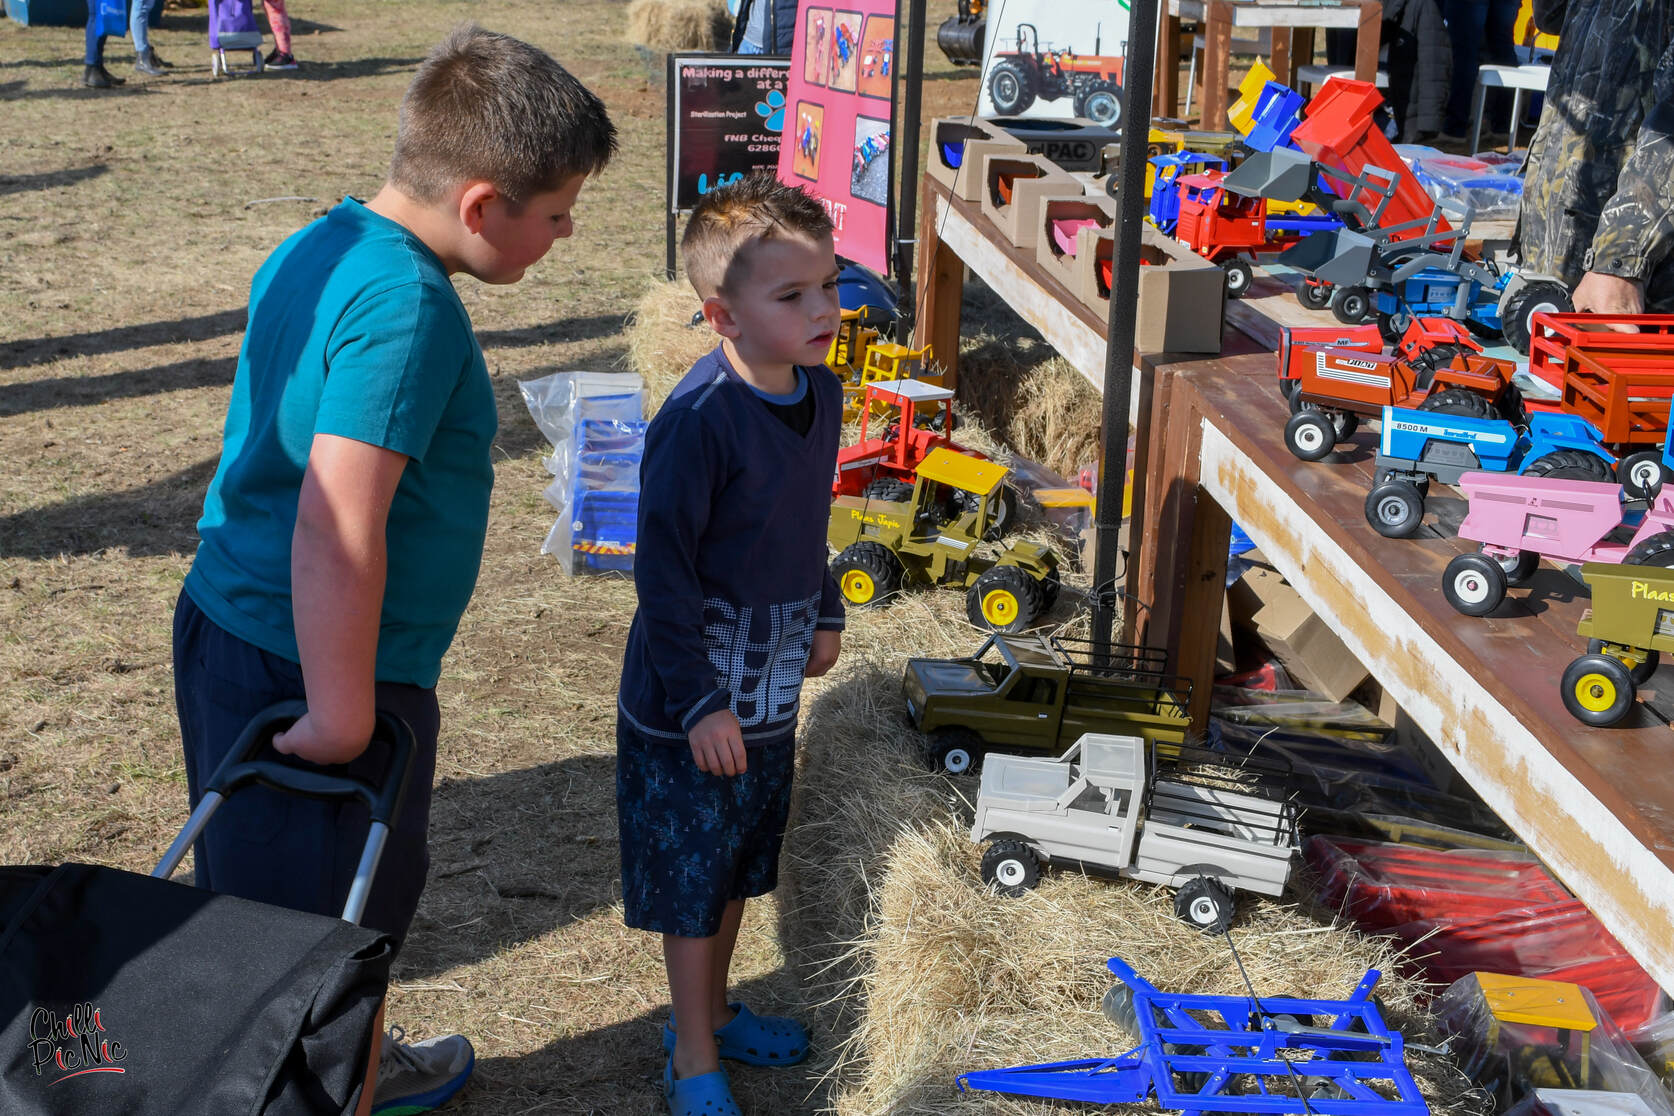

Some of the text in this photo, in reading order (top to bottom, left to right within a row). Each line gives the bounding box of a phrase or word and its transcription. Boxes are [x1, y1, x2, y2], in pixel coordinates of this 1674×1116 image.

[682, 67, 732, 82] Making
[735, 69, 744, 78] a
[756, 79, 784, 90] at a
[724, 134, 748, 142] FNB
[1396, 422, 1429, 433] 8500 M
